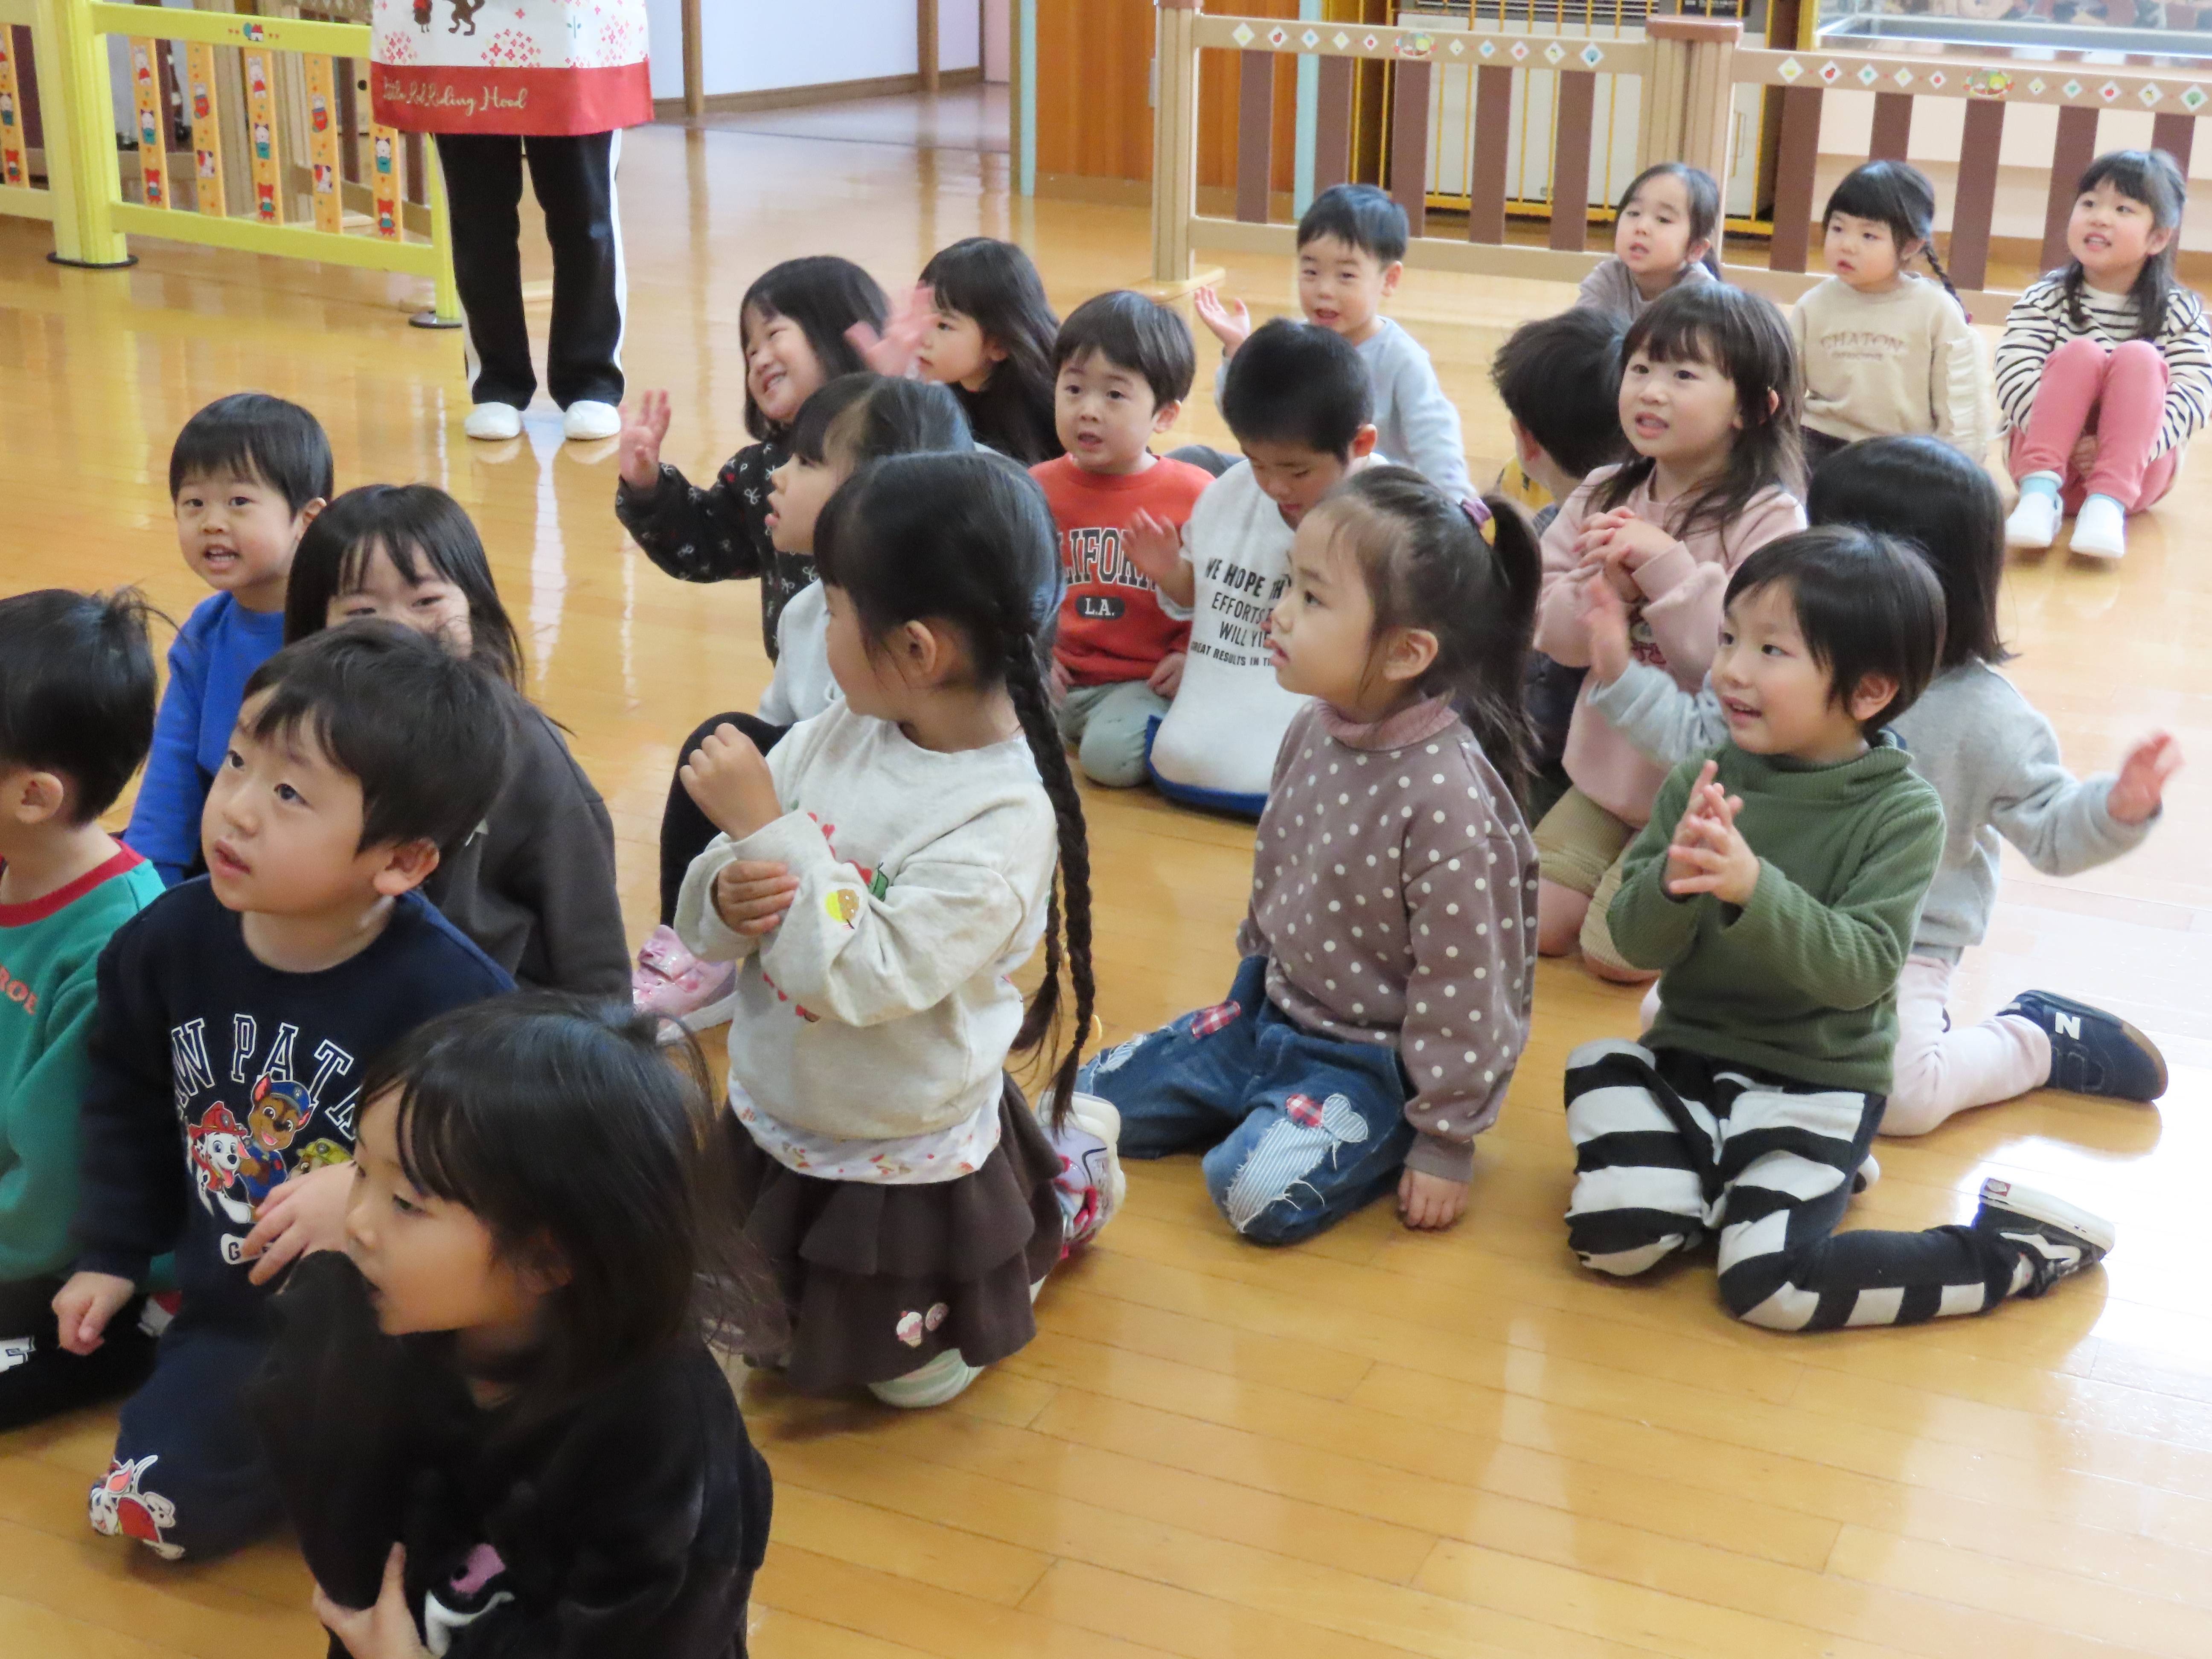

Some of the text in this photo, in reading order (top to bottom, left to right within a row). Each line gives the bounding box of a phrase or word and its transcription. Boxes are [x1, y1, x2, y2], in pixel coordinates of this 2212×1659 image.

[479, 86, 528, 111] Hood
[1223, 564, 1266, 597] HOPE
[1085, 597, 1115, 616] L.A.
[1211, 591, 1265, 624] EFFORTS
[1219, 621, 1245, 646] WILL
[1213, 649, 1246, 666] RESULTS
[1250, 658, 1259, 666] IN
[2055, 1011, 2081, 1041] N
